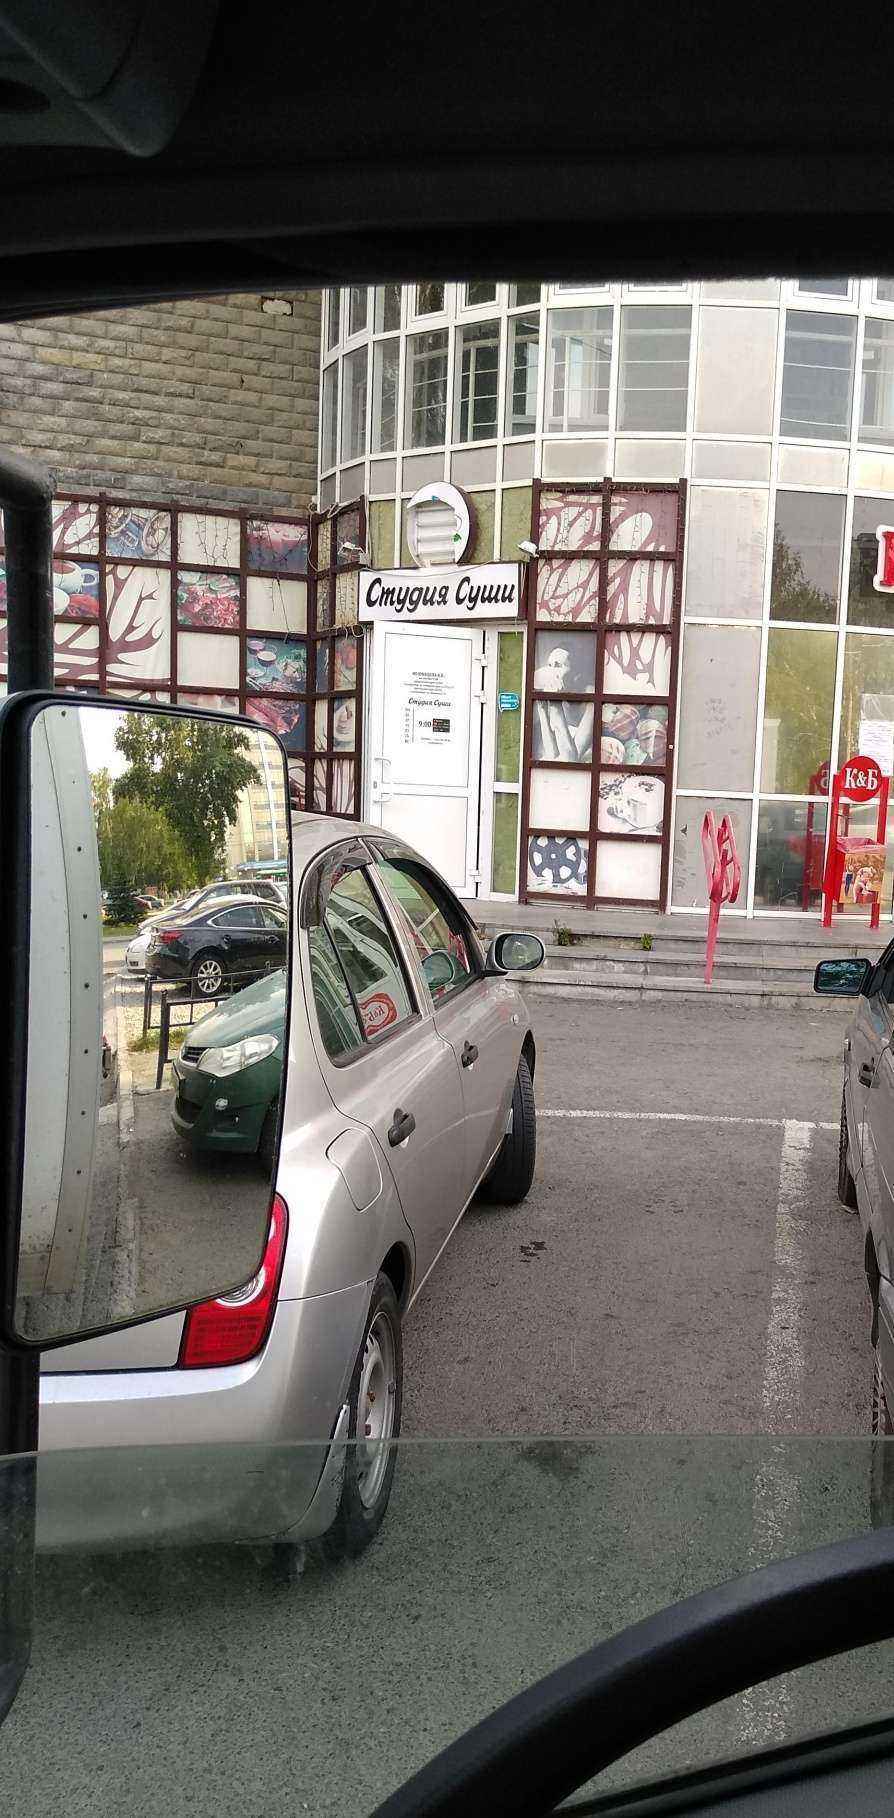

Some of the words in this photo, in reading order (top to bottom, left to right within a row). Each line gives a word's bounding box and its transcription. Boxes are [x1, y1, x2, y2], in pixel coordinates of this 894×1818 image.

[366, 577, 450, 613] Студия
[455, 576, 515, 611] Суши
[844, 767, 878, 790] К&Б
